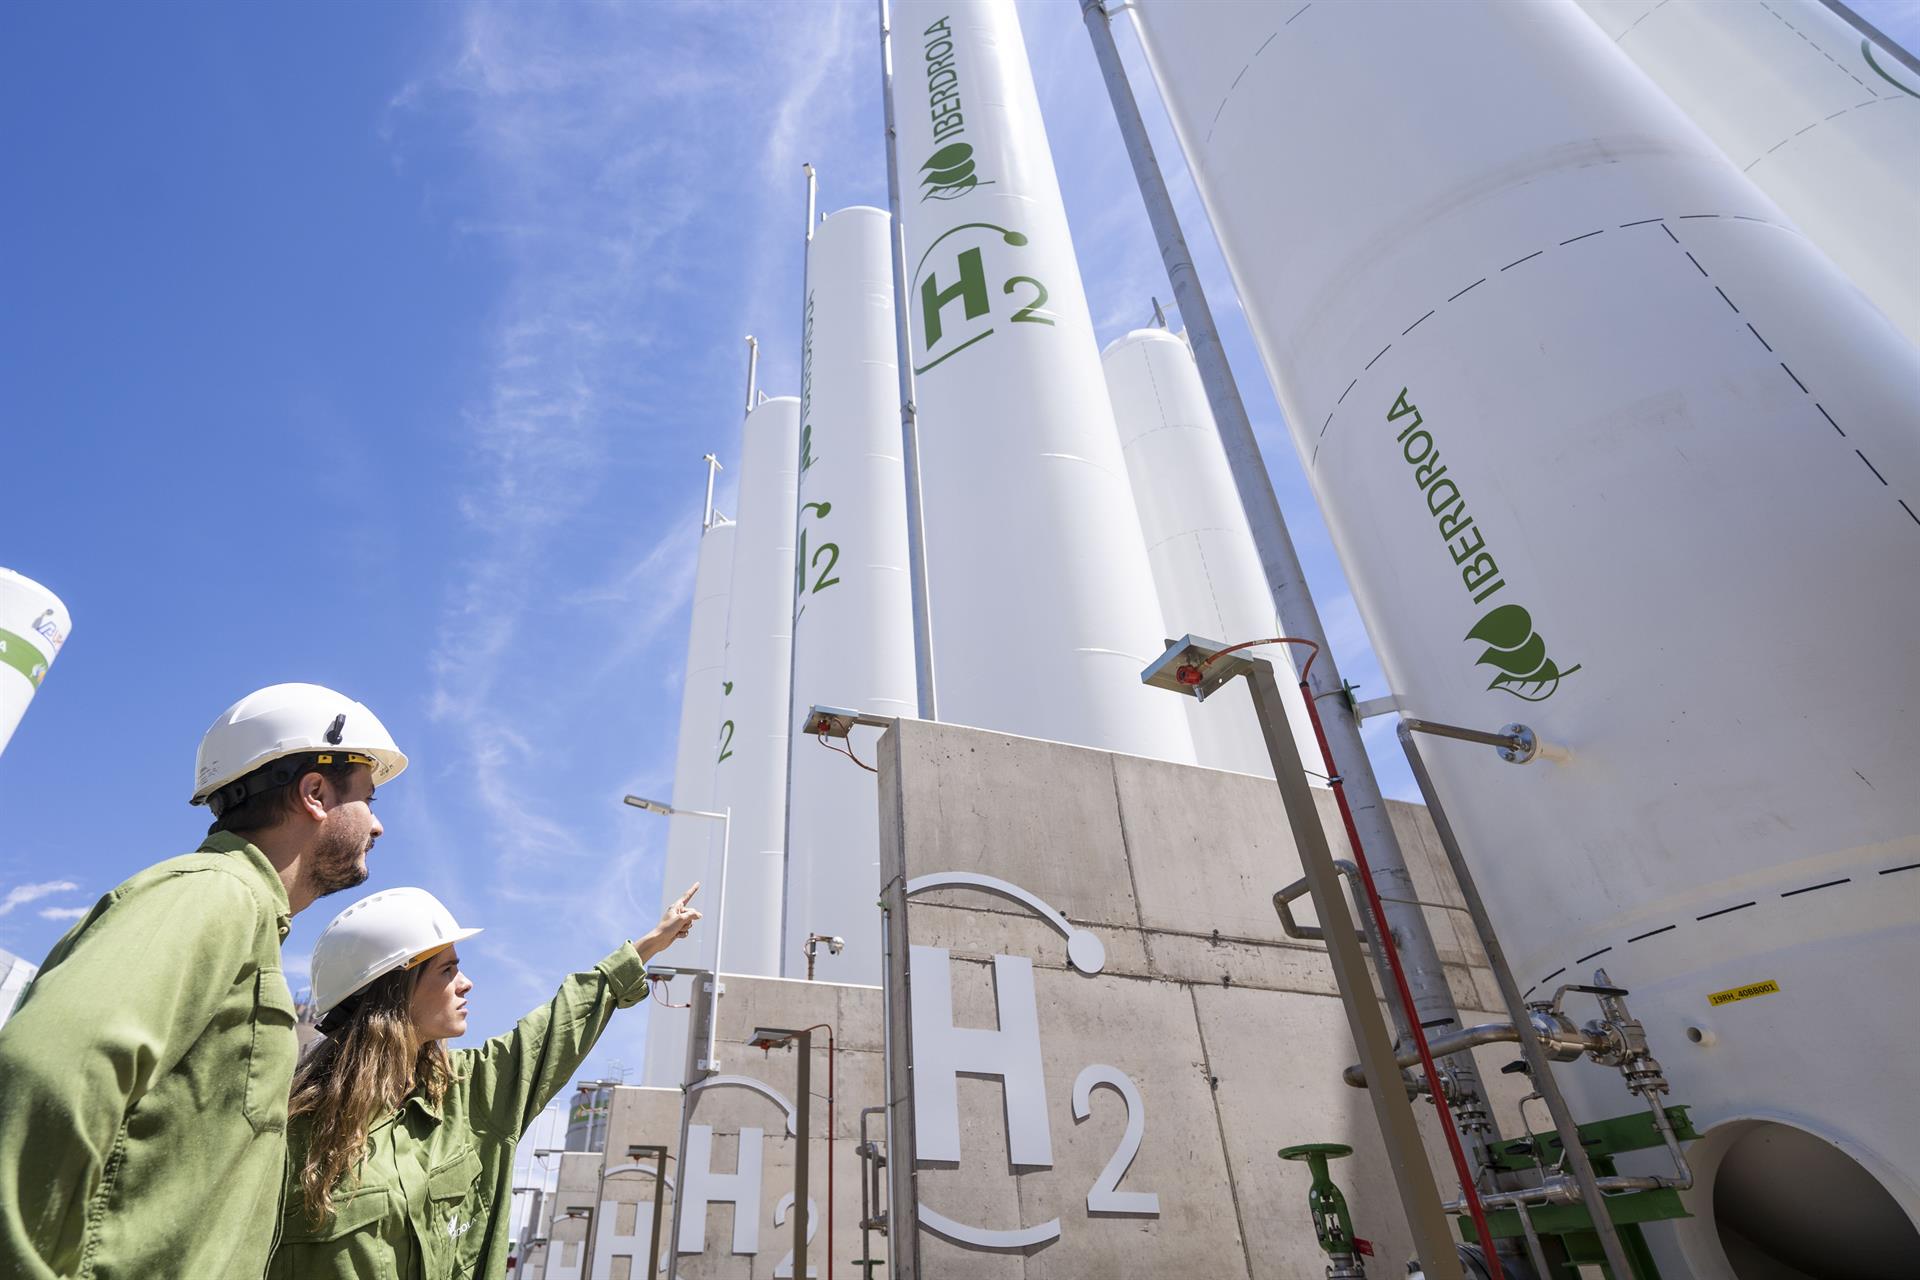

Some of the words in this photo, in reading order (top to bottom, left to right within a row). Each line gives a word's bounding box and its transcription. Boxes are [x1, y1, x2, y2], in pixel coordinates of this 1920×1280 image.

[924, 16, 964, 145] IBERDROLA
[1386, 386, 1506, 605] IBERDROLA
[908, 944, 1160, 1214] H2
